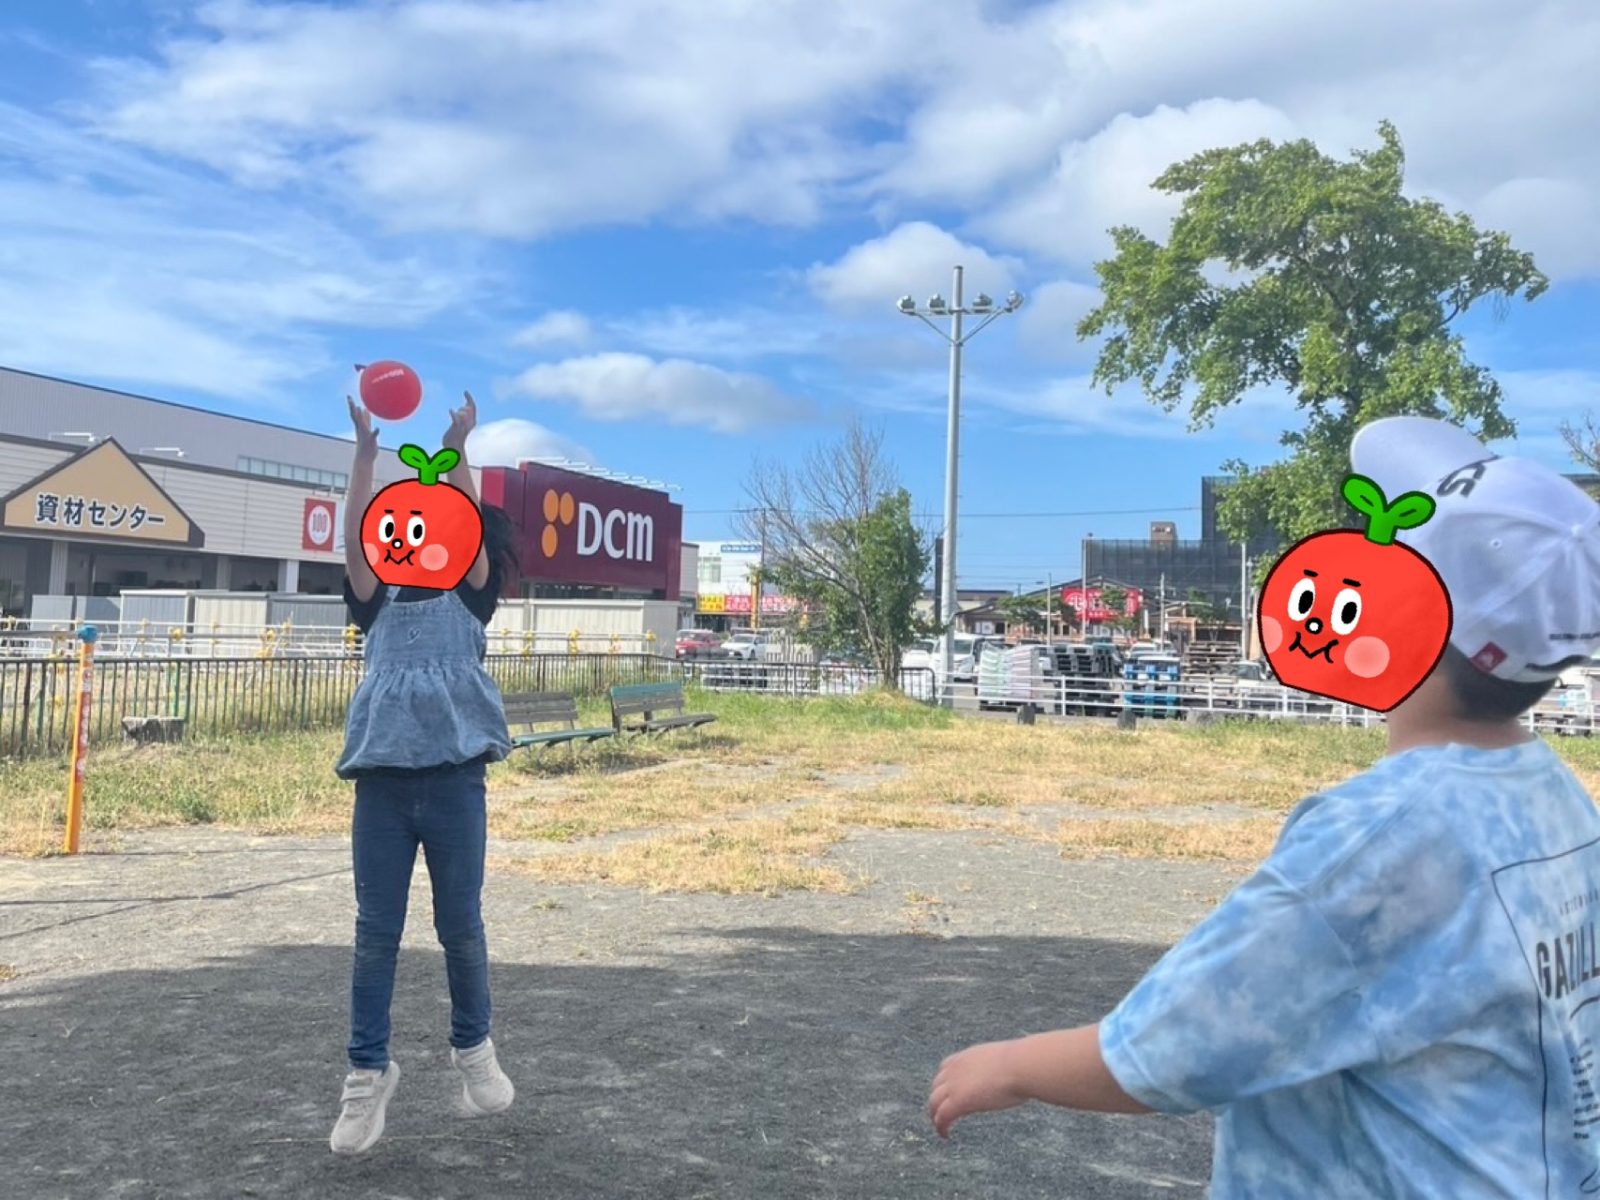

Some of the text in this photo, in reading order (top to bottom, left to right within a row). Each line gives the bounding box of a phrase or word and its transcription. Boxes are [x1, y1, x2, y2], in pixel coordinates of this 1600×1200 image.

[36, 493, 164, 530] 資材センター
